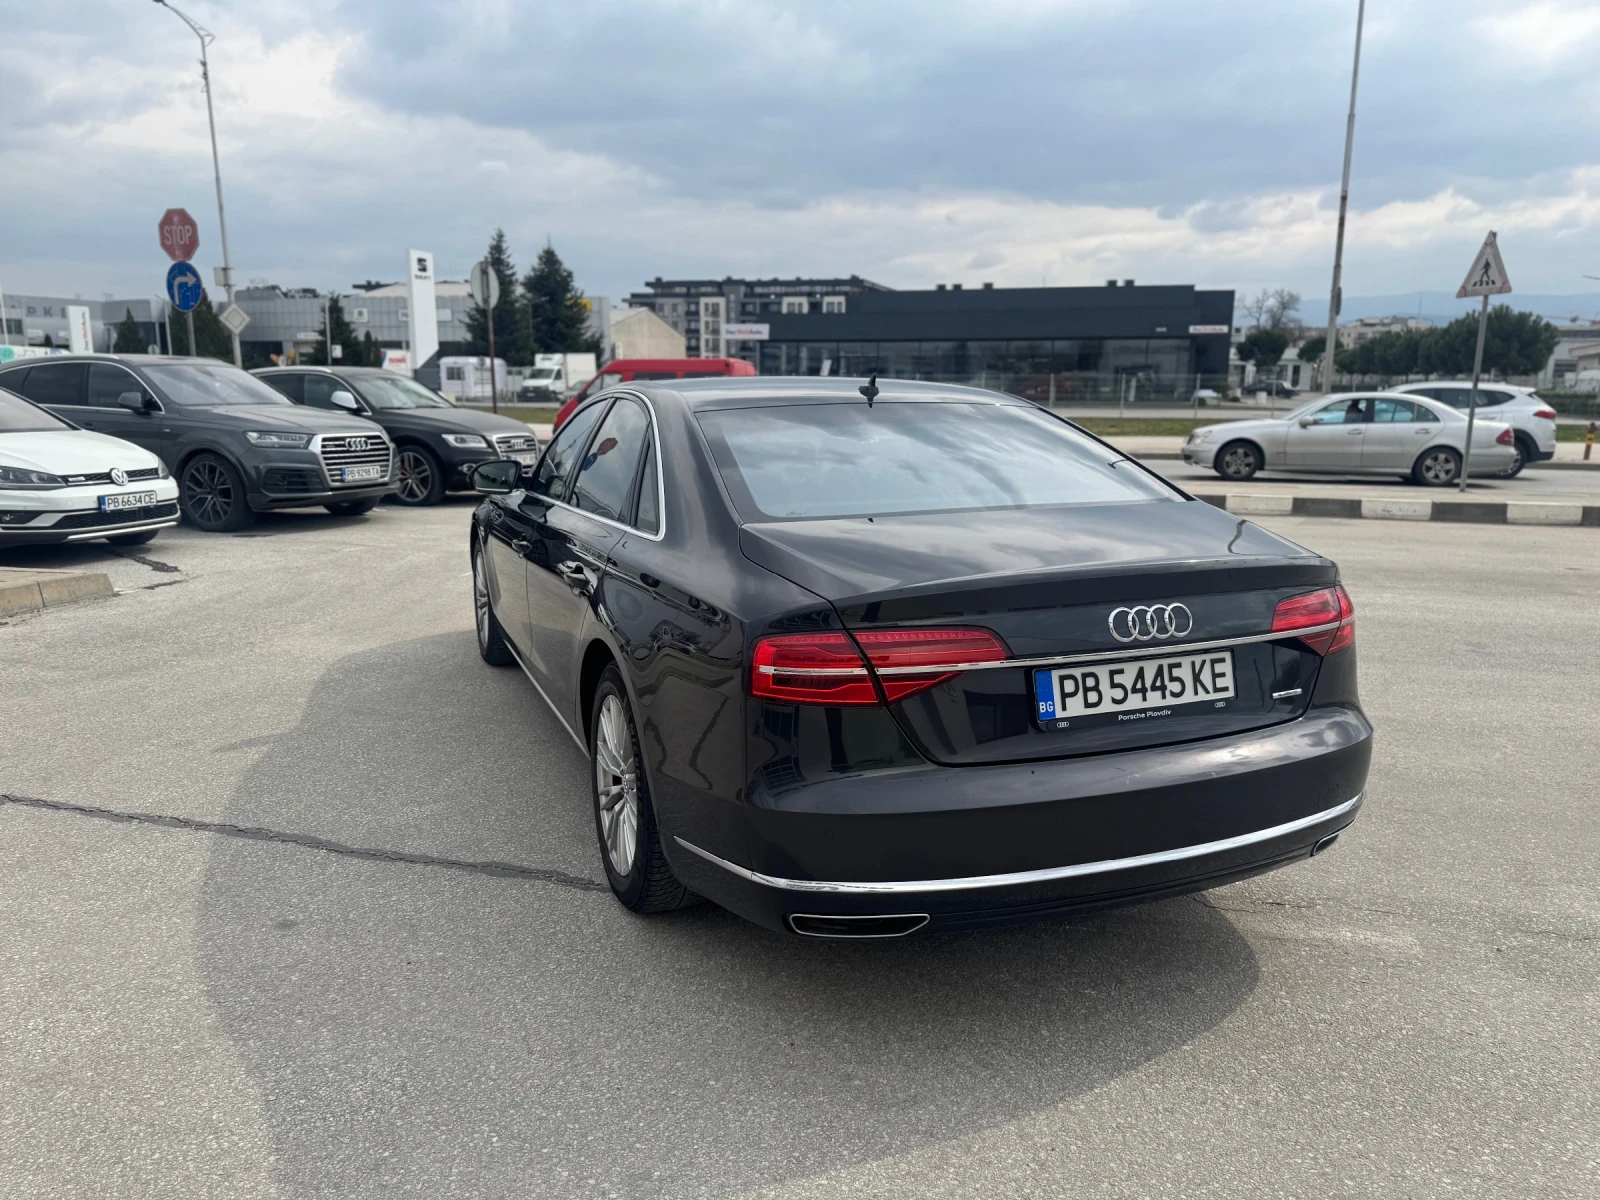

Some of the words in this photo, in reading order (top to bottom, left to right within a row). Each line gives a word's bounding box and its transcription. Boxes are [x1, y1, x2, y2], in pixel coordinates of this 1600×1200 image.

[164, 225, 192, 245] STOP
[347, 470, 355, 478] PB
[356, 468, 371, 477] 9298
[107, 497, 120, 509] PB
[121, 495, 143, 507] 6634
[143, 493, 155, 504] CE
[1058, 672, 1103, 711] PB
[1108, 662, 1186, 705] 5445
[1190, 657, 1230, 696] KE
[1039, 702, 1054, 713] BG
[1118, 712, 1145, 721] Porsche
[1146, 709, 1172, 718] Plovdiv
